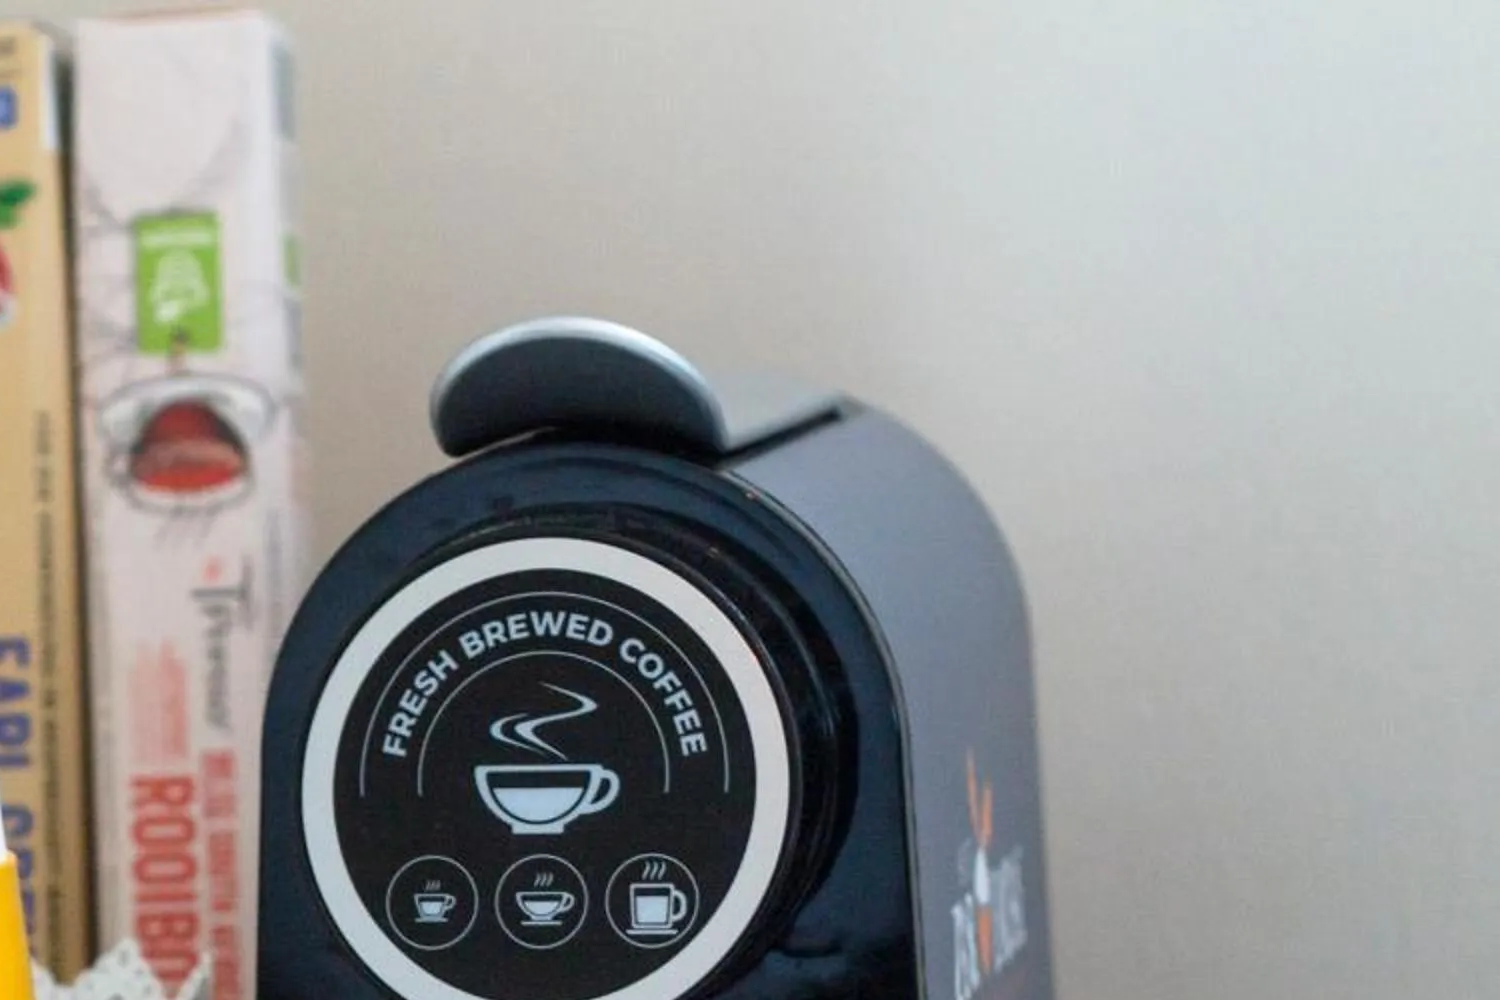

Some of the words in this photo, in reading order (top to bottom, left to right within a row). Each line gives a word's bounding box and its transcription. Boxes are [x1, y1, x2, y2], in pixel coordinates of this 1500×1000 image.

[382, 650, 459, 757] FRESH
[458, 611, 614, 660] BREWED
[618, 638, 708, 757] COFFEE
[132, 775, 199, 1000] ROOIBO
